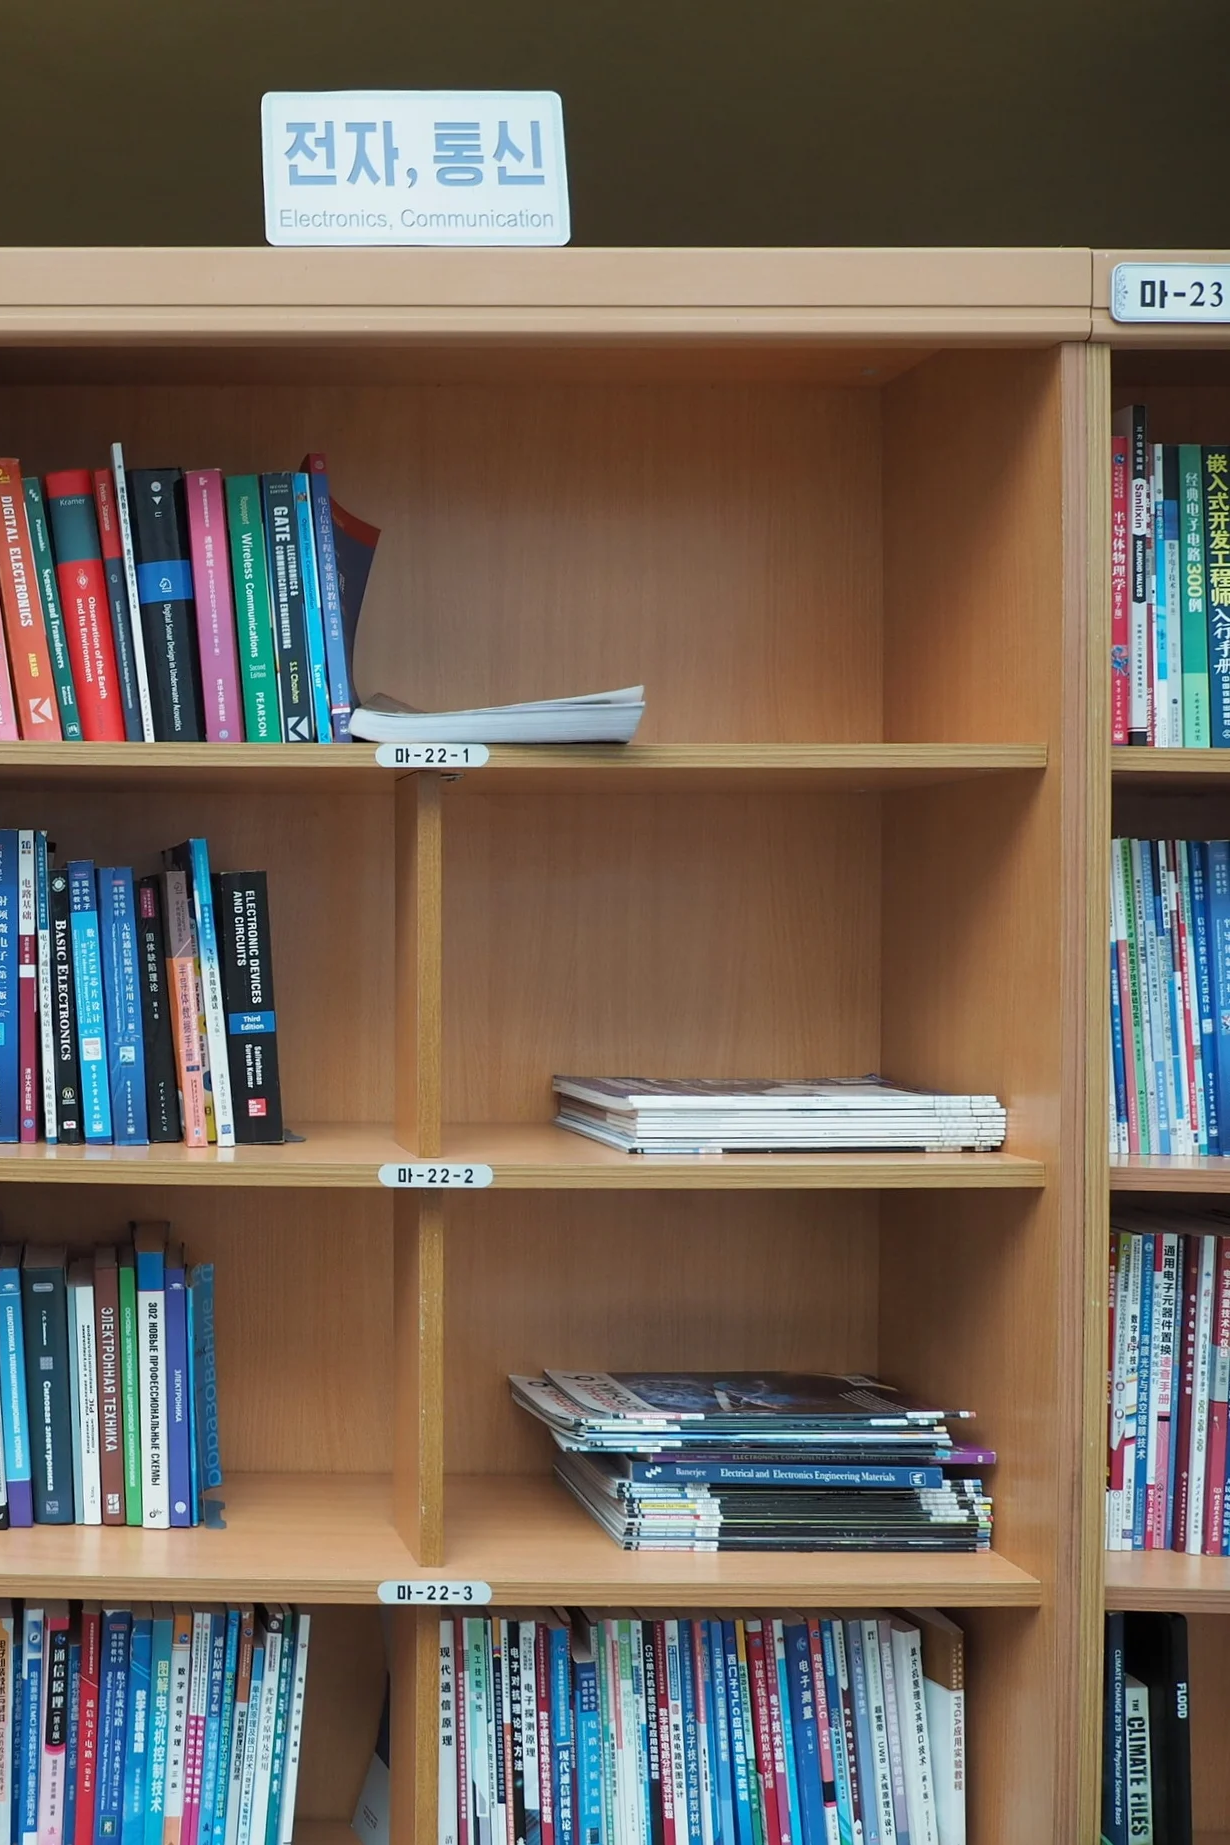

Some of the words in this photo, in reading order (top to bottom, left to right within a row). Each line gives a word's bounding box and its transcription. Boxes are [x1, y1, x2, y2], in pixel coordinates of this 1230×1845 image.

[283, 119, 418, 190] 전자,
[433, 119, 547, 188] 통신
[279, 208, 394, 232] Electronics,
[400, 208, 555, 230] Communication
[1139, 279, 1224, 308] 마-23
[1, 496, 19, 543] DIGITAL
[59, 498, 86, 507] Kramer
[273, 506, 291, 543] GATE
[1134, 483, 1144, 530] Sanlixin
[241, 532, 254, 580] Wireless
[287, 544, 299, 590] ELECTRONICS
[1135, 540, 1144, 570] SOLENOID
[1185, 471, 1203, 613] 经典电子电路300例
[9, 547, 34, 628] ELECTRONICS
[275, 545, 288, 602] COMMUNICATION
[42, 568, 53, 602] Sensors
[50, 619, 65, 669] Transducers
[245, 582, 259, 659] Communications
[279, 603, 291, 650] ENGINEERING
[80, 628, 93, 683] Environment
[87, 596, 101, 650] Observation
[98, 676, 108, 699] Earth
[313, 664, 322, 689] Kaur
[256, 692, 268, 737] PEARSON
[395, 748, 469, 764] 마-22-1
[21, 877, 32, 921] 电路基础
[233, 890, 244, 914] AND
[245, 890, 259, 957] ELECTRONIC
[54, 919, 67, 961] BASIC
[145, 932, 159, 993] 固体缺陷理论
[234, 916, 247, 967] CIRCUITS
[249, 957, 262, 1005] DEVICES
[56, 964, 71, 1062] ELECTRONICS
[241, 1023, 265, 1031] Edition
[243, 1014, 261, 1023] Third
[397, 1167, 473, 1183] 마-22-2
[148, 1302, 158, 1320] 302
[148, 1322, 159, 1353] НОВЫЕ
[1158, 1244, 1175, 1406] 通用电子元器件置换速查手册
[101, 1306, 116, 1394] ЭЛЕКТРОННАЯ
[42, 1380, 52, 1424] Силовая
[149, 1355, 161, 1451] ПРОФЕССИОНАЛЬНЫЕ
[174, 1368, 183, 1423] ЭЛЕКТРОНИКА
[1136, 1334, 1150, 1460] 薄膜光学与真空镀膜技术
[103, 1396, 118, 1453] ТЕХНИКА
[44, 1425, 54, 1492] электроника
[150, 1453, 161, 1487] СХЕМЫ
[675, 1467, 707, 1478] Banerjee
[720, 1468, 754, 1478] Electrical
[755, 1469, 770, 1478] and
[773, 1469, 814, 1480] Electronics
[814, 1470, 860, 1482] Engineering
[861, 1471, 896, 1482] Materials
[396, 1585, 473, 1600] 마-22-3
[51, 1649, 66, 1709] 通信原理
[439, 1646, 454, 1747] 现代通信原理
[797, 1659, 814, 1721] 电子测量
[1176, 1682, 1188, 1720] FLOOD
[172, 1666, 187, 1748] 数字信号处理
[509, 1647, 524, 1772] 电子对抗理论与方法
[523, 1682, 537, 1758] 电子探测原理
[769, 1693, 786, 1774] 电子技术基础
[149, 1660, 170, 1813] 图解电动机控制技术
[1127, 1716, 1148, 1787] CLIMATE
[539, 1710, 554, 1824] 数字逻辑电路分析与设计教程
[558, 1749, 573, 1831] 现代通信网概论
[586, 1719, 601, 1816] 电路分析基础
[1131, 1793, 1149, 1836] FILES
